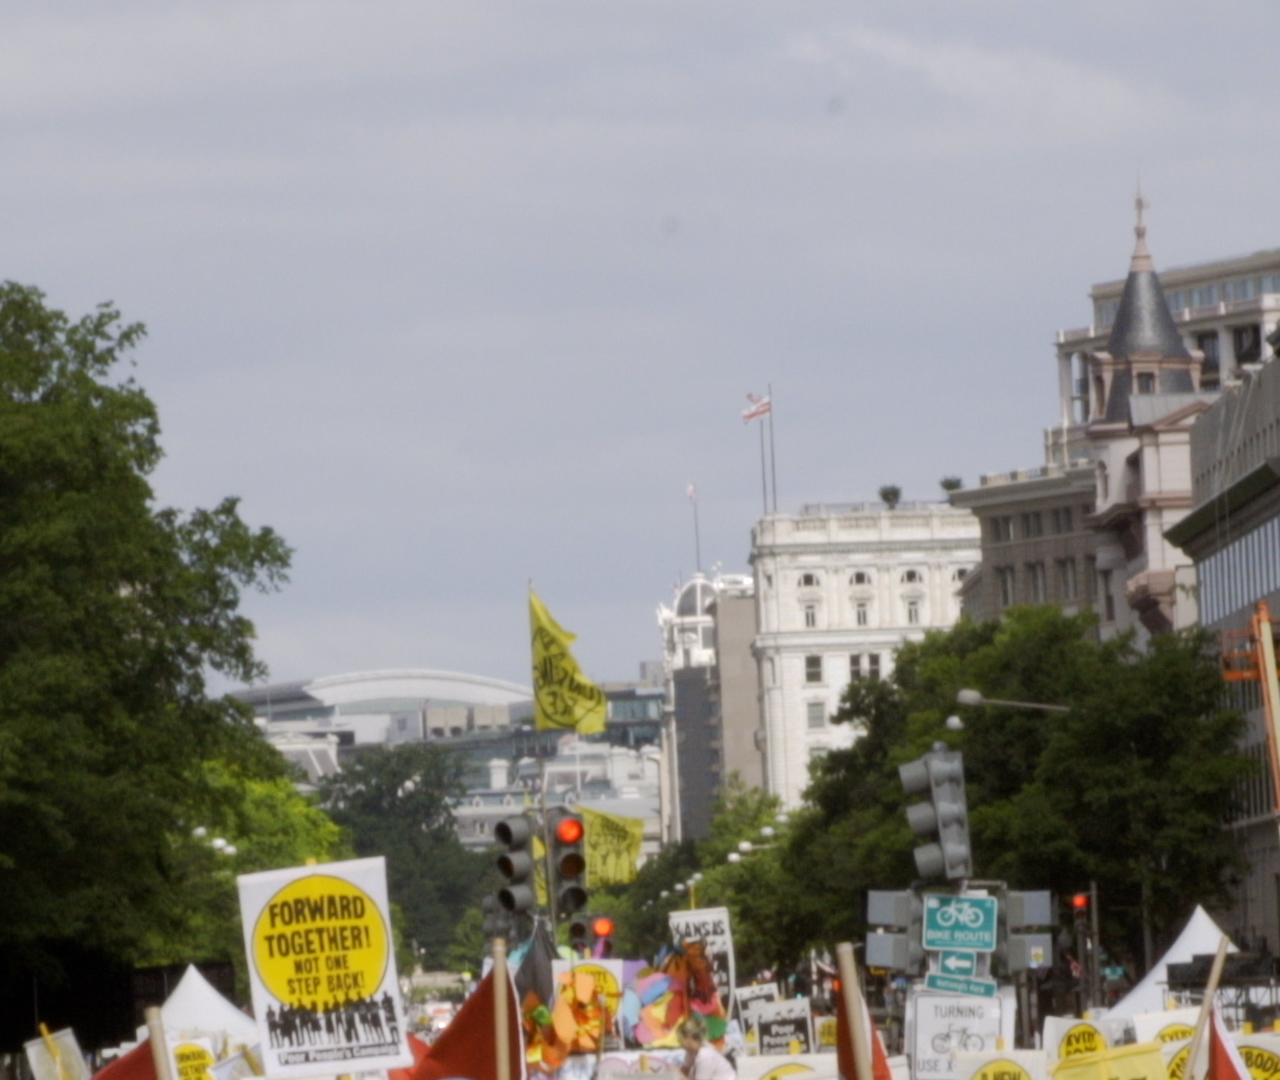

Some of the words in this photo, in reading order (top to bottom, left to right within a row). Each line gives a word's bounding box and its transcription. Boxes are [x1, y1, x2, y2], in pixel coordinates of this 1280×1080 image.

[269, 896, 366, 928] FORWARD
[265, 927, 371, 959] TOGETHER!
[927, 929, 951, 940] BIKE
[955, 930, 991, 941] ROUTE
[294, 958, 320, 975] NOT
[325, 953, 349, 972] ONE
[287, 977, 320, 995] STEP
[327, 974, 365, 993] BACK!
[934, 1005, 984, 1019] TURNING
[280, 1051, 307, 1063] Poor
[308, 1047, 351, 1061] People's
[917, 1060, 939, 1072] USE
